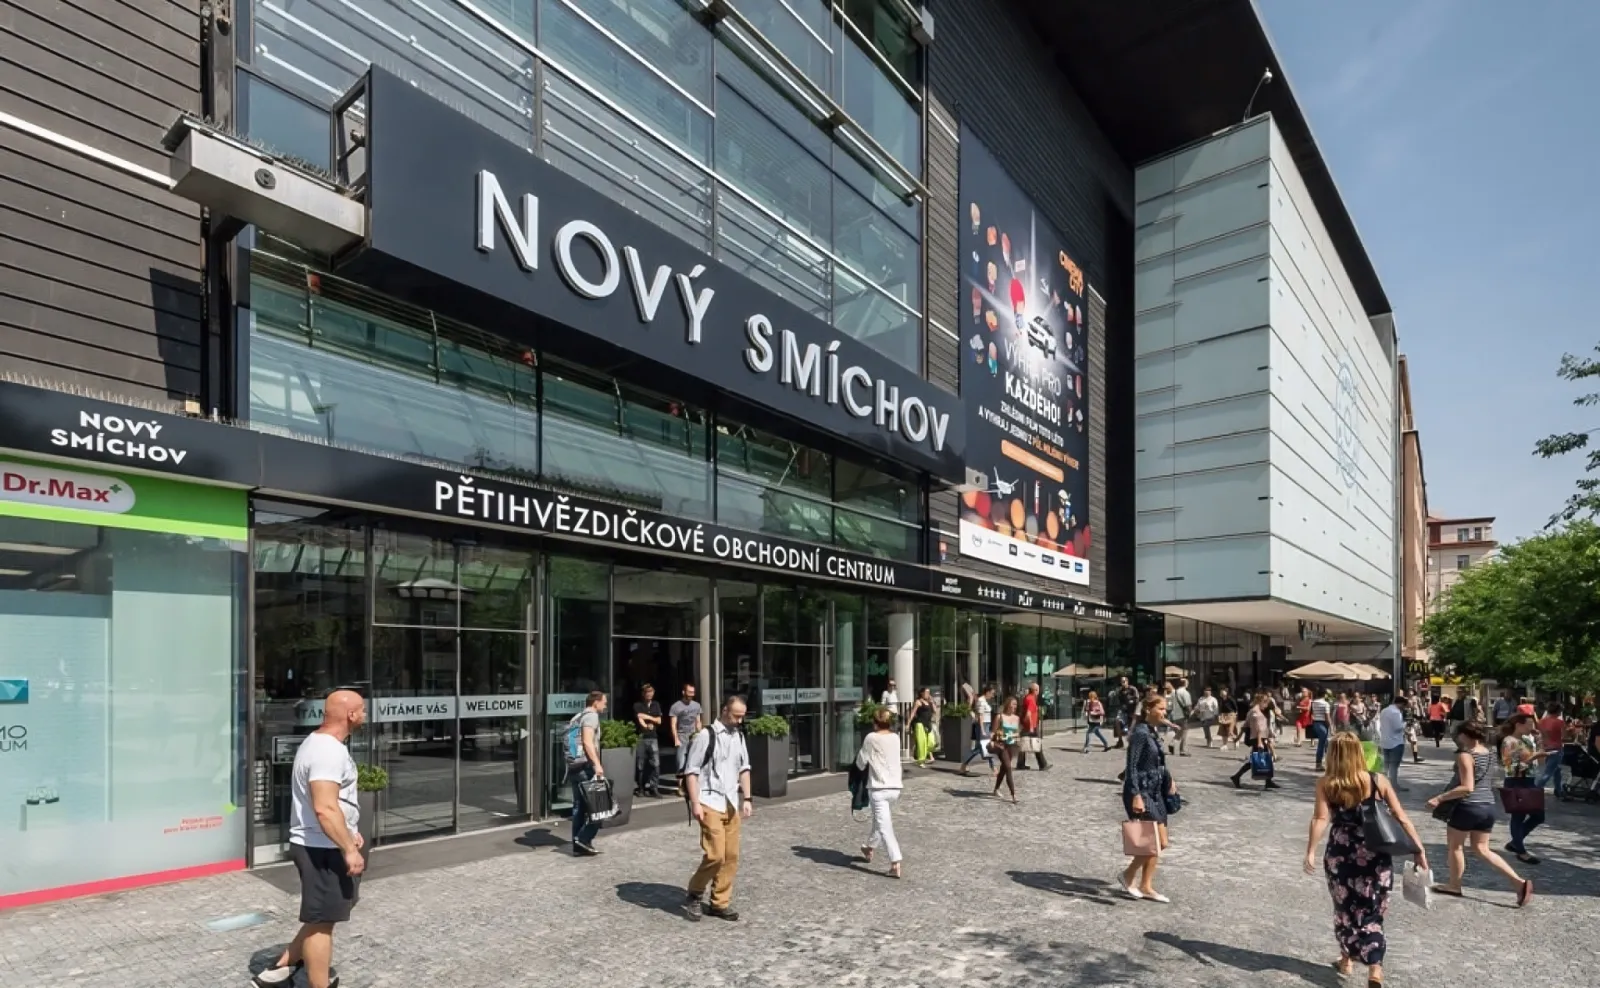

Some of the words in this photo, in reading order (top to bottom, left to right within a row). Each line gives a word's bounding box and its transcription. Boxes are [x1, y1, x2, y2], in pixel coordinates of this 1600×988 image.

[476, 169, 715, 344] NOVÝ
[745, 313, 950, 452] SMÍCHOV
[1005, 371, 1061, 427] KAŽDÉHO!
[80, 410, 163, 439] NOVÝ
[51, 429, 187, 465] SMÍCHOV
[3, 472, 110, 503] Dr.Max
[435, 476, 704, 554] PĚTIHVĚZDIČKOVÉ
[713, 536, 820, 573] OBCHODNÍ
[827, 556, 896, 586] CENTRUM
[378, 702, 423, 716] VÍTÁME
[426, 702, 448, 714] VÁS
[466, 700, 523, 711] WELCOME
